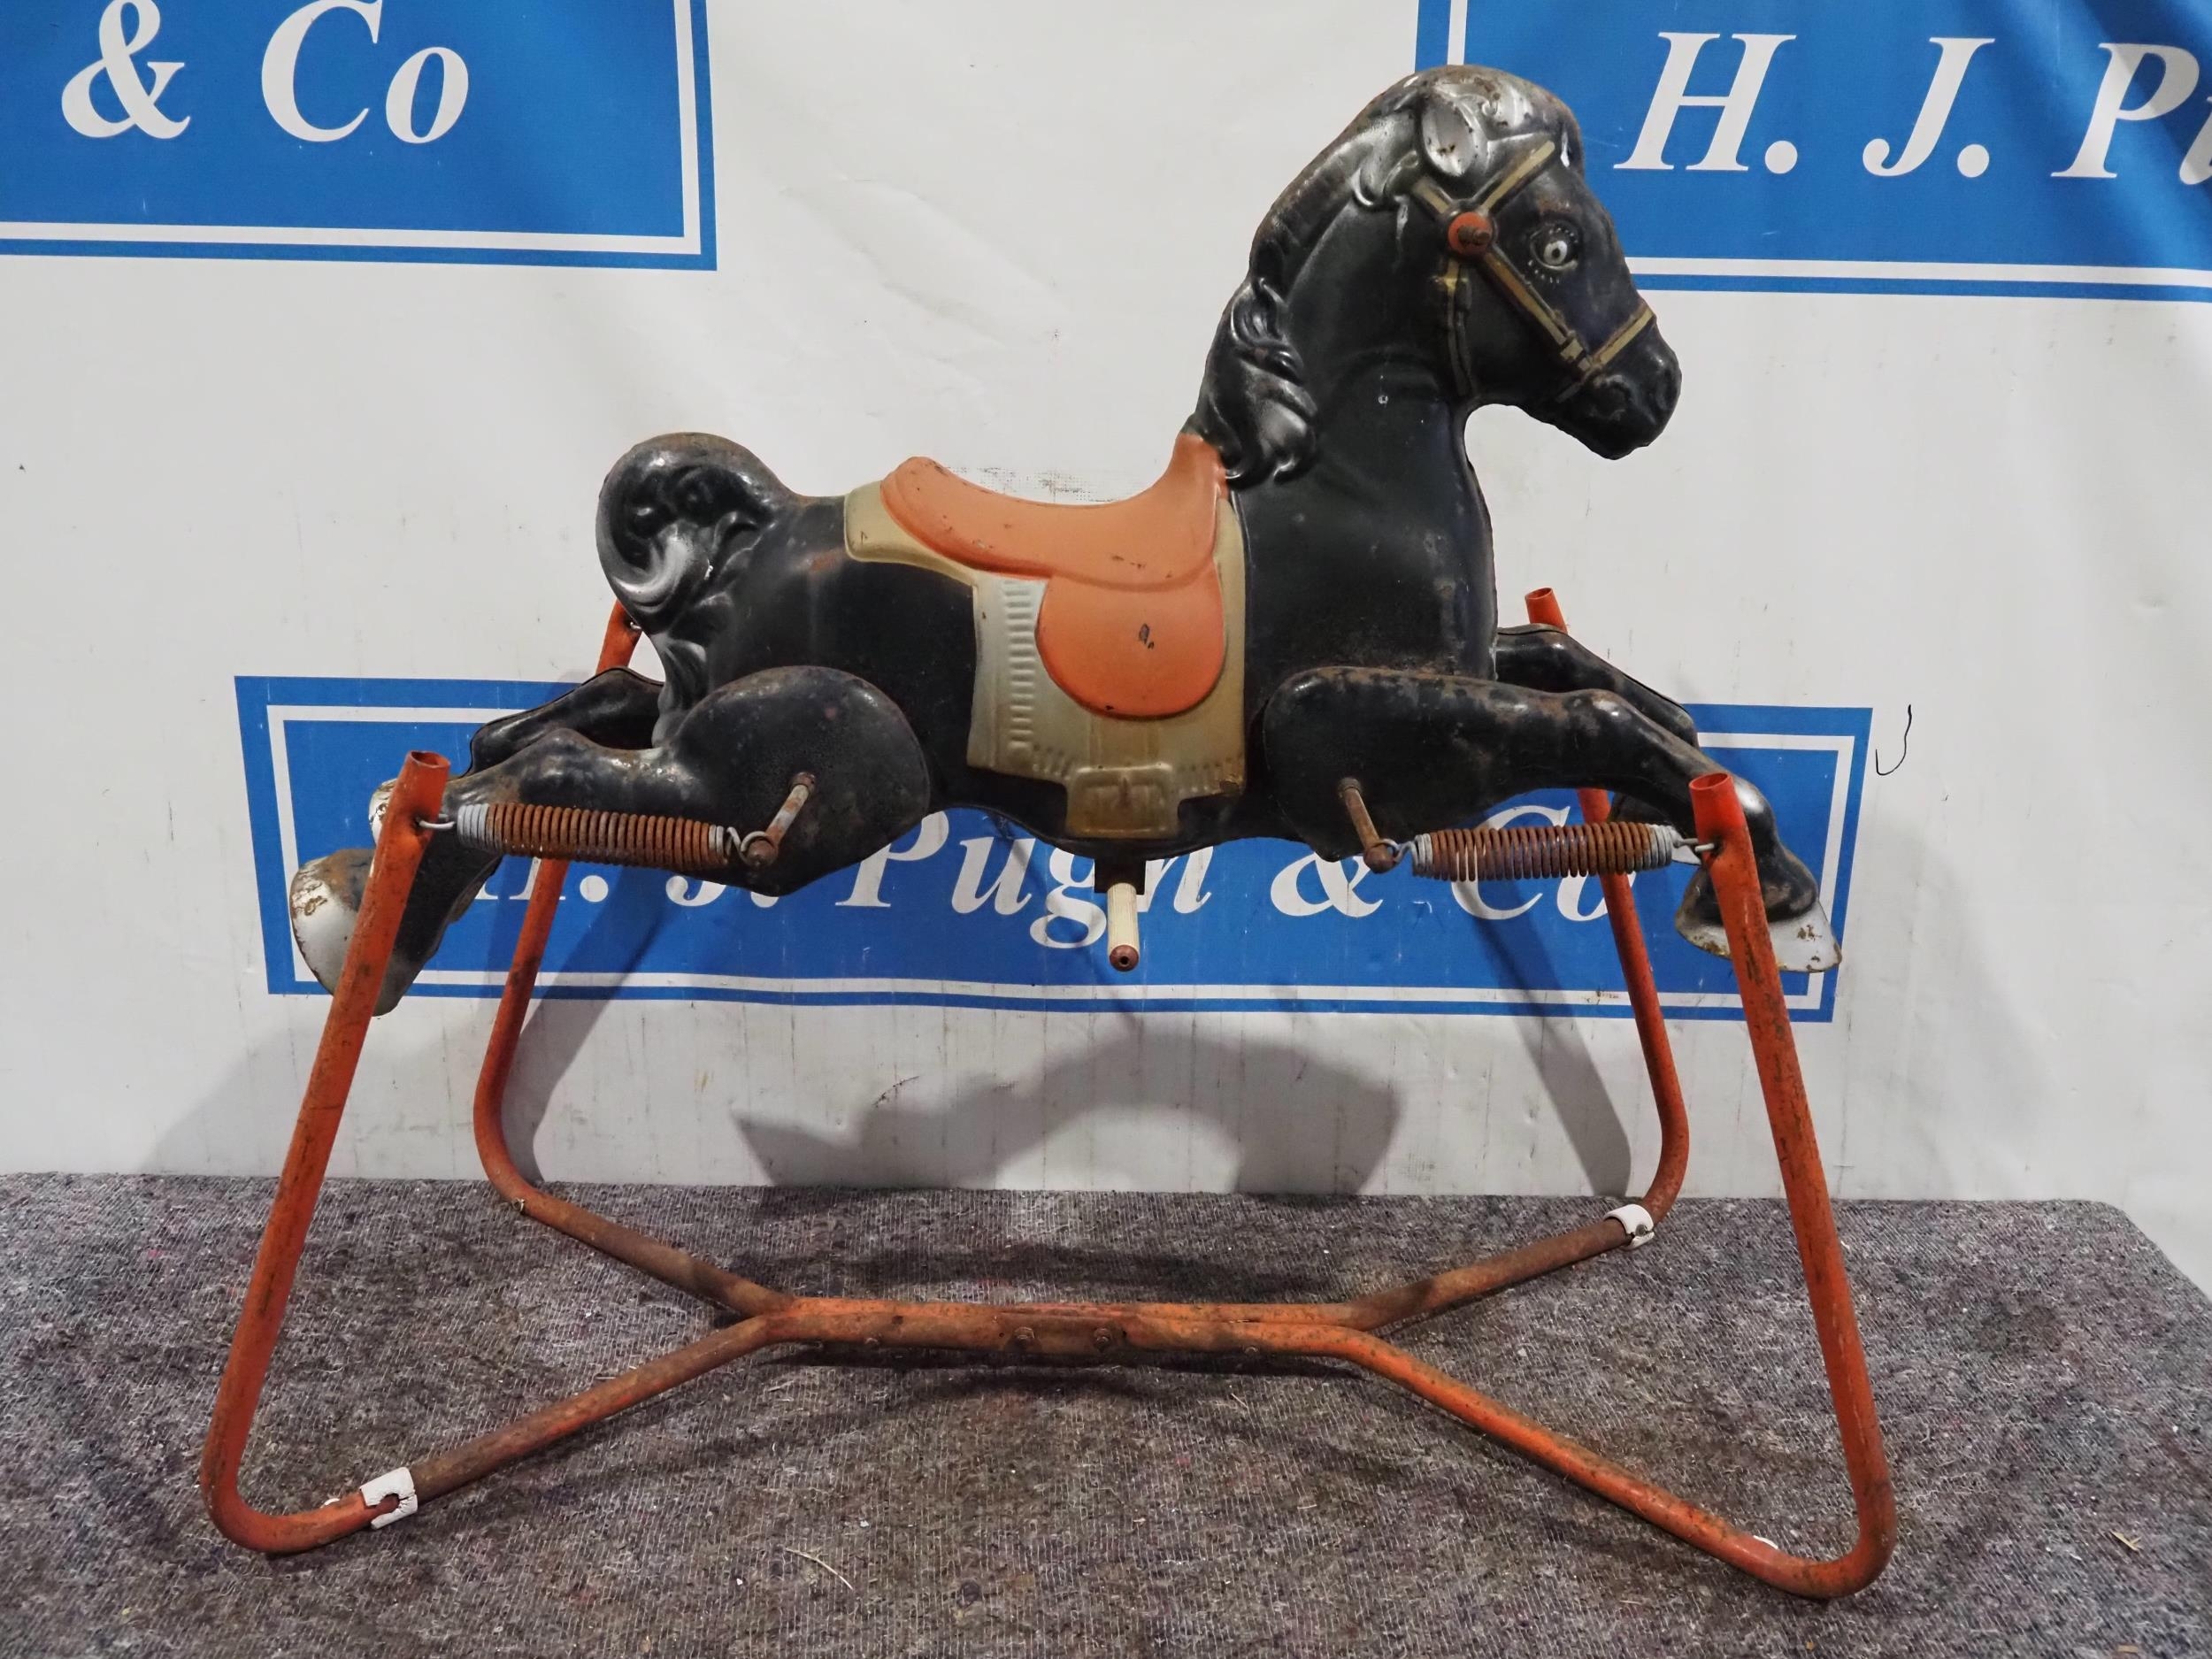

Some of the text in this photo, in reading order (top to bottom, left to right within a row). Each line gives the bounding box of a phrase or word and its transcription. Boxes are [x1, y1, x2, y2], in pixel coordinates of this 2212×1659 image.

[61, 0, 470, 144] & Co
[1613, 32, 1798, 174] H.
[1863, 37, 1990, 178] J.
[1270, 851, 1384, 918] &
